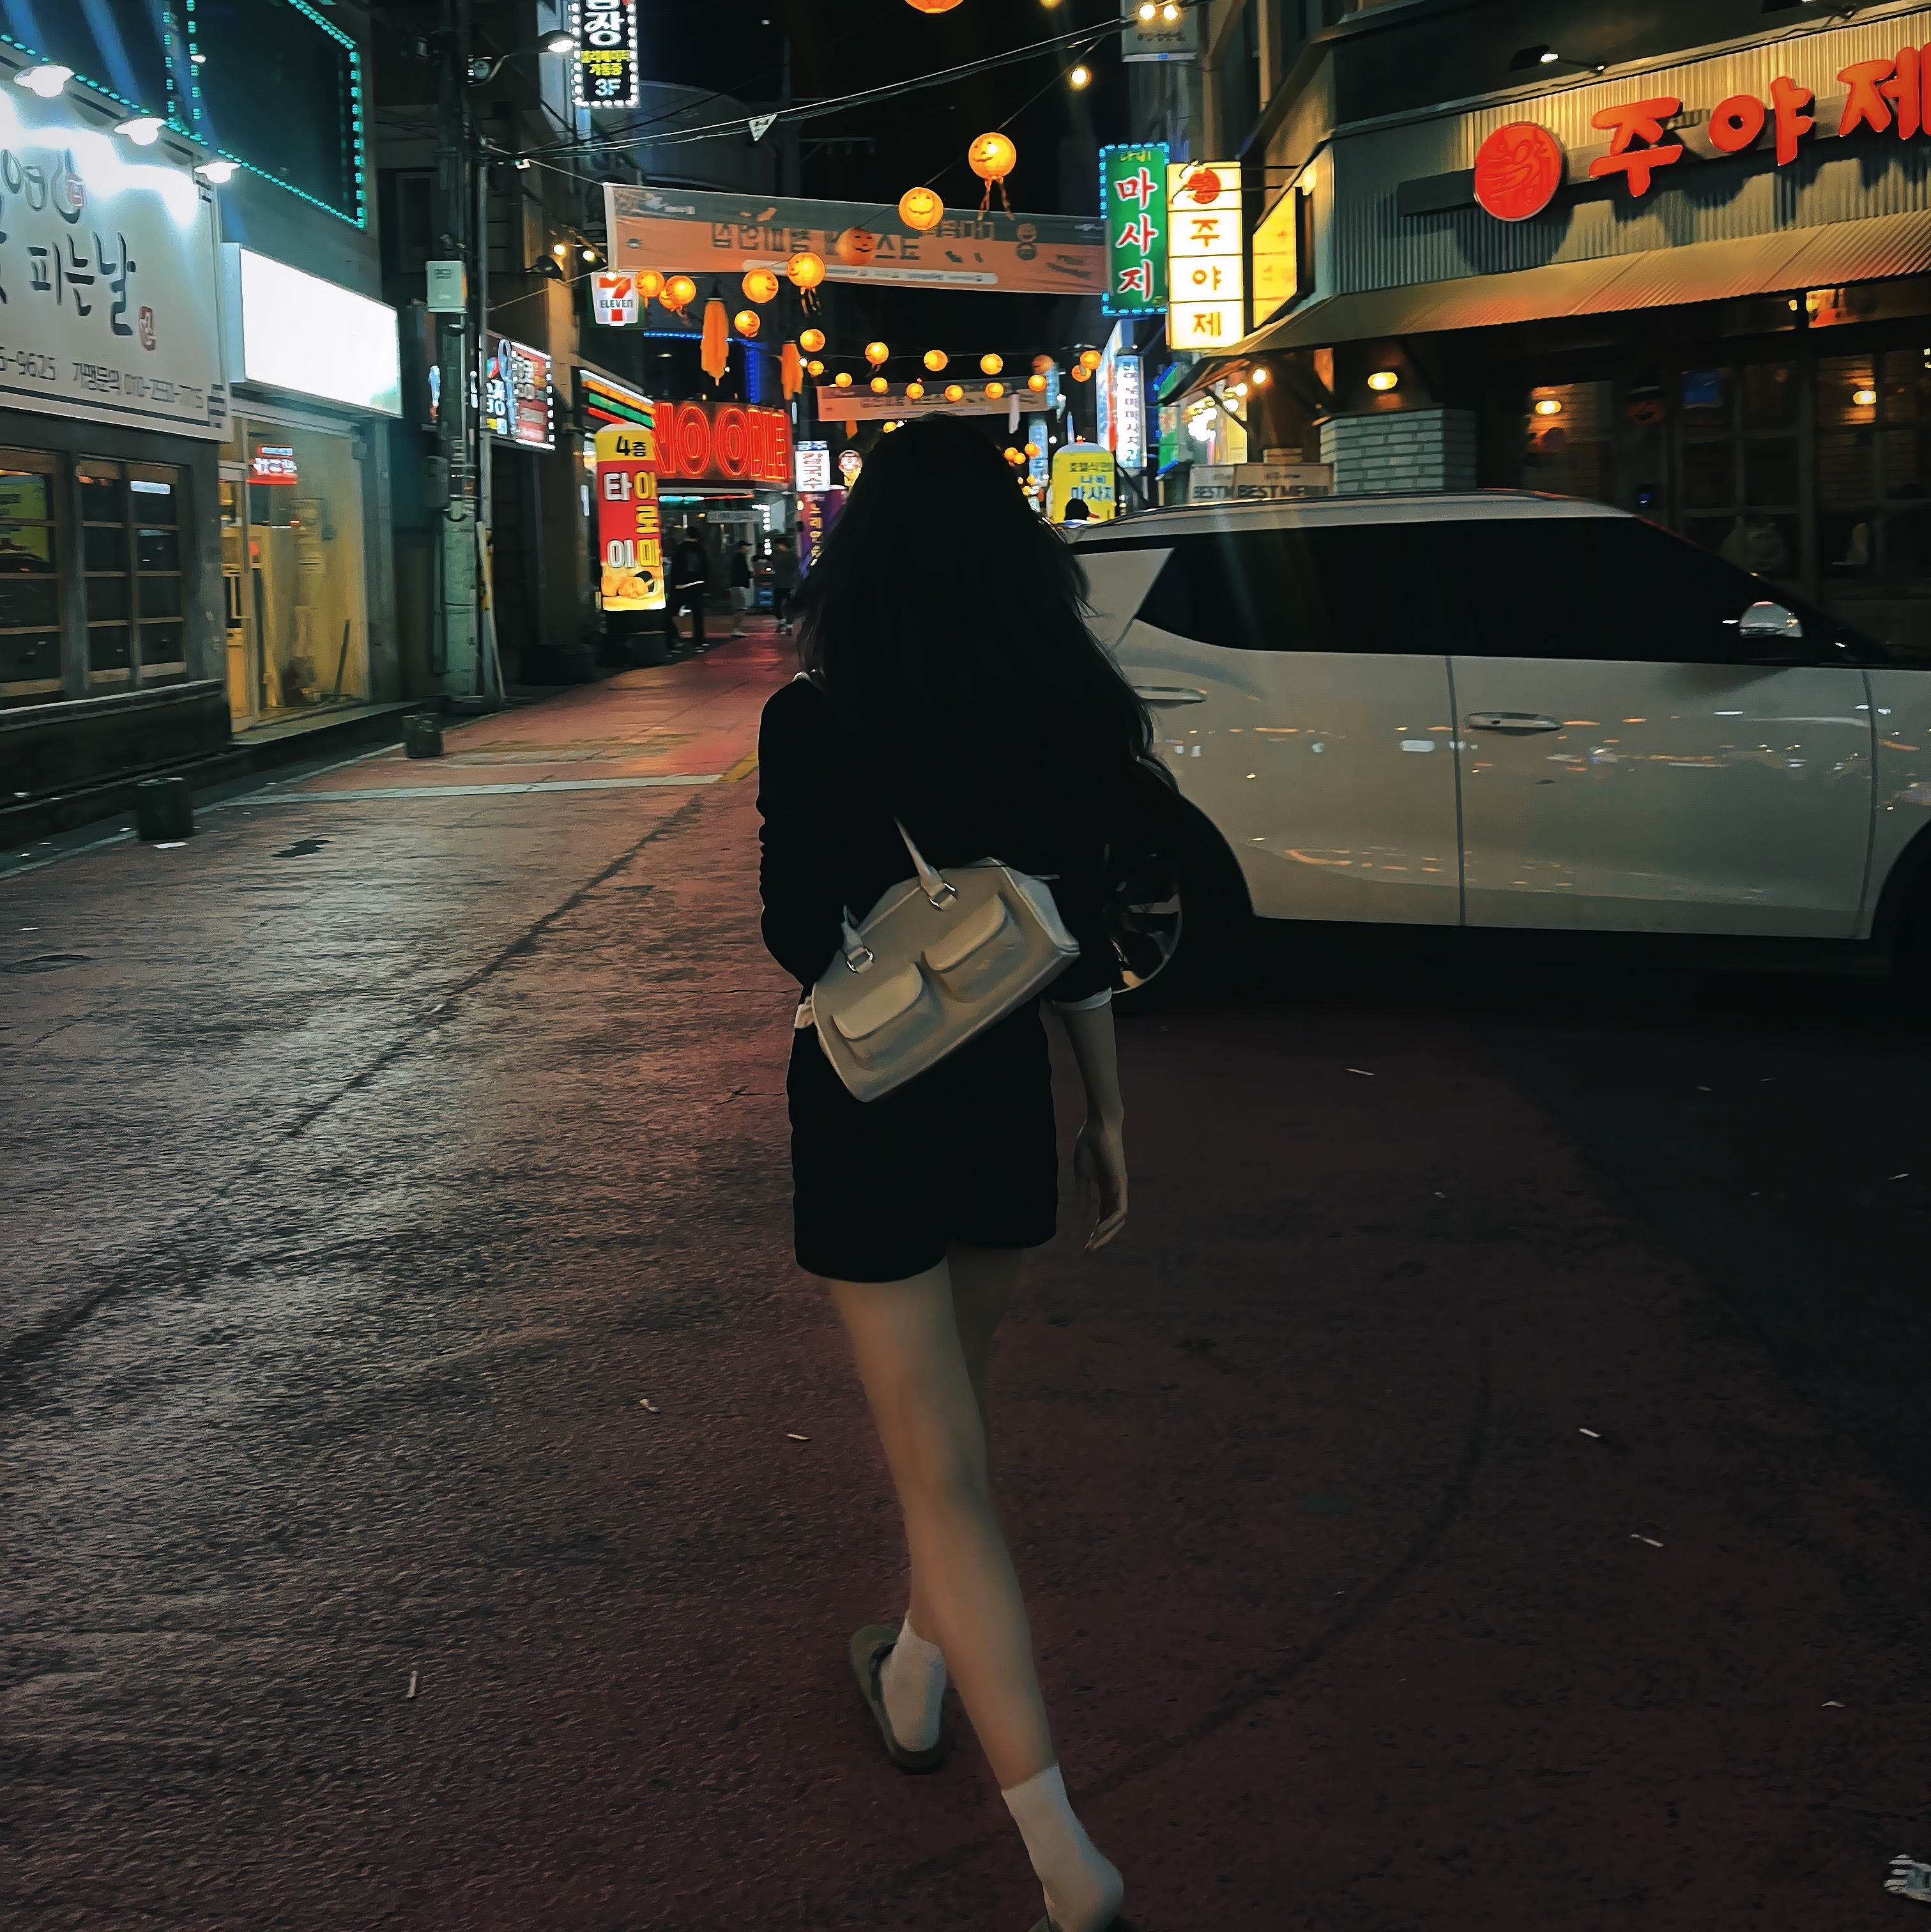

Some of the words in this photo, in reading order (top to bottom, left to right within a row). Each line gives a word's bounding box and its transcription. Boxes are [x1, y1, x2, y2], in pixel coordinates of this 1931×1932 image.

[595, 78, 622, 96] 3F
[1590, 42, 1931, 197] 주야제
[1114, 167, 1159, 302] 마사지
[1191, 219, 1222, 337] 주야제
[598, 277, 632, 321] 7
[615, 435, 646, 457] 4층
[1238, 485, 1278, 498] BEST
[603, 471, 636, 568] 타이
[634, 470, 662, 567] 아로마
